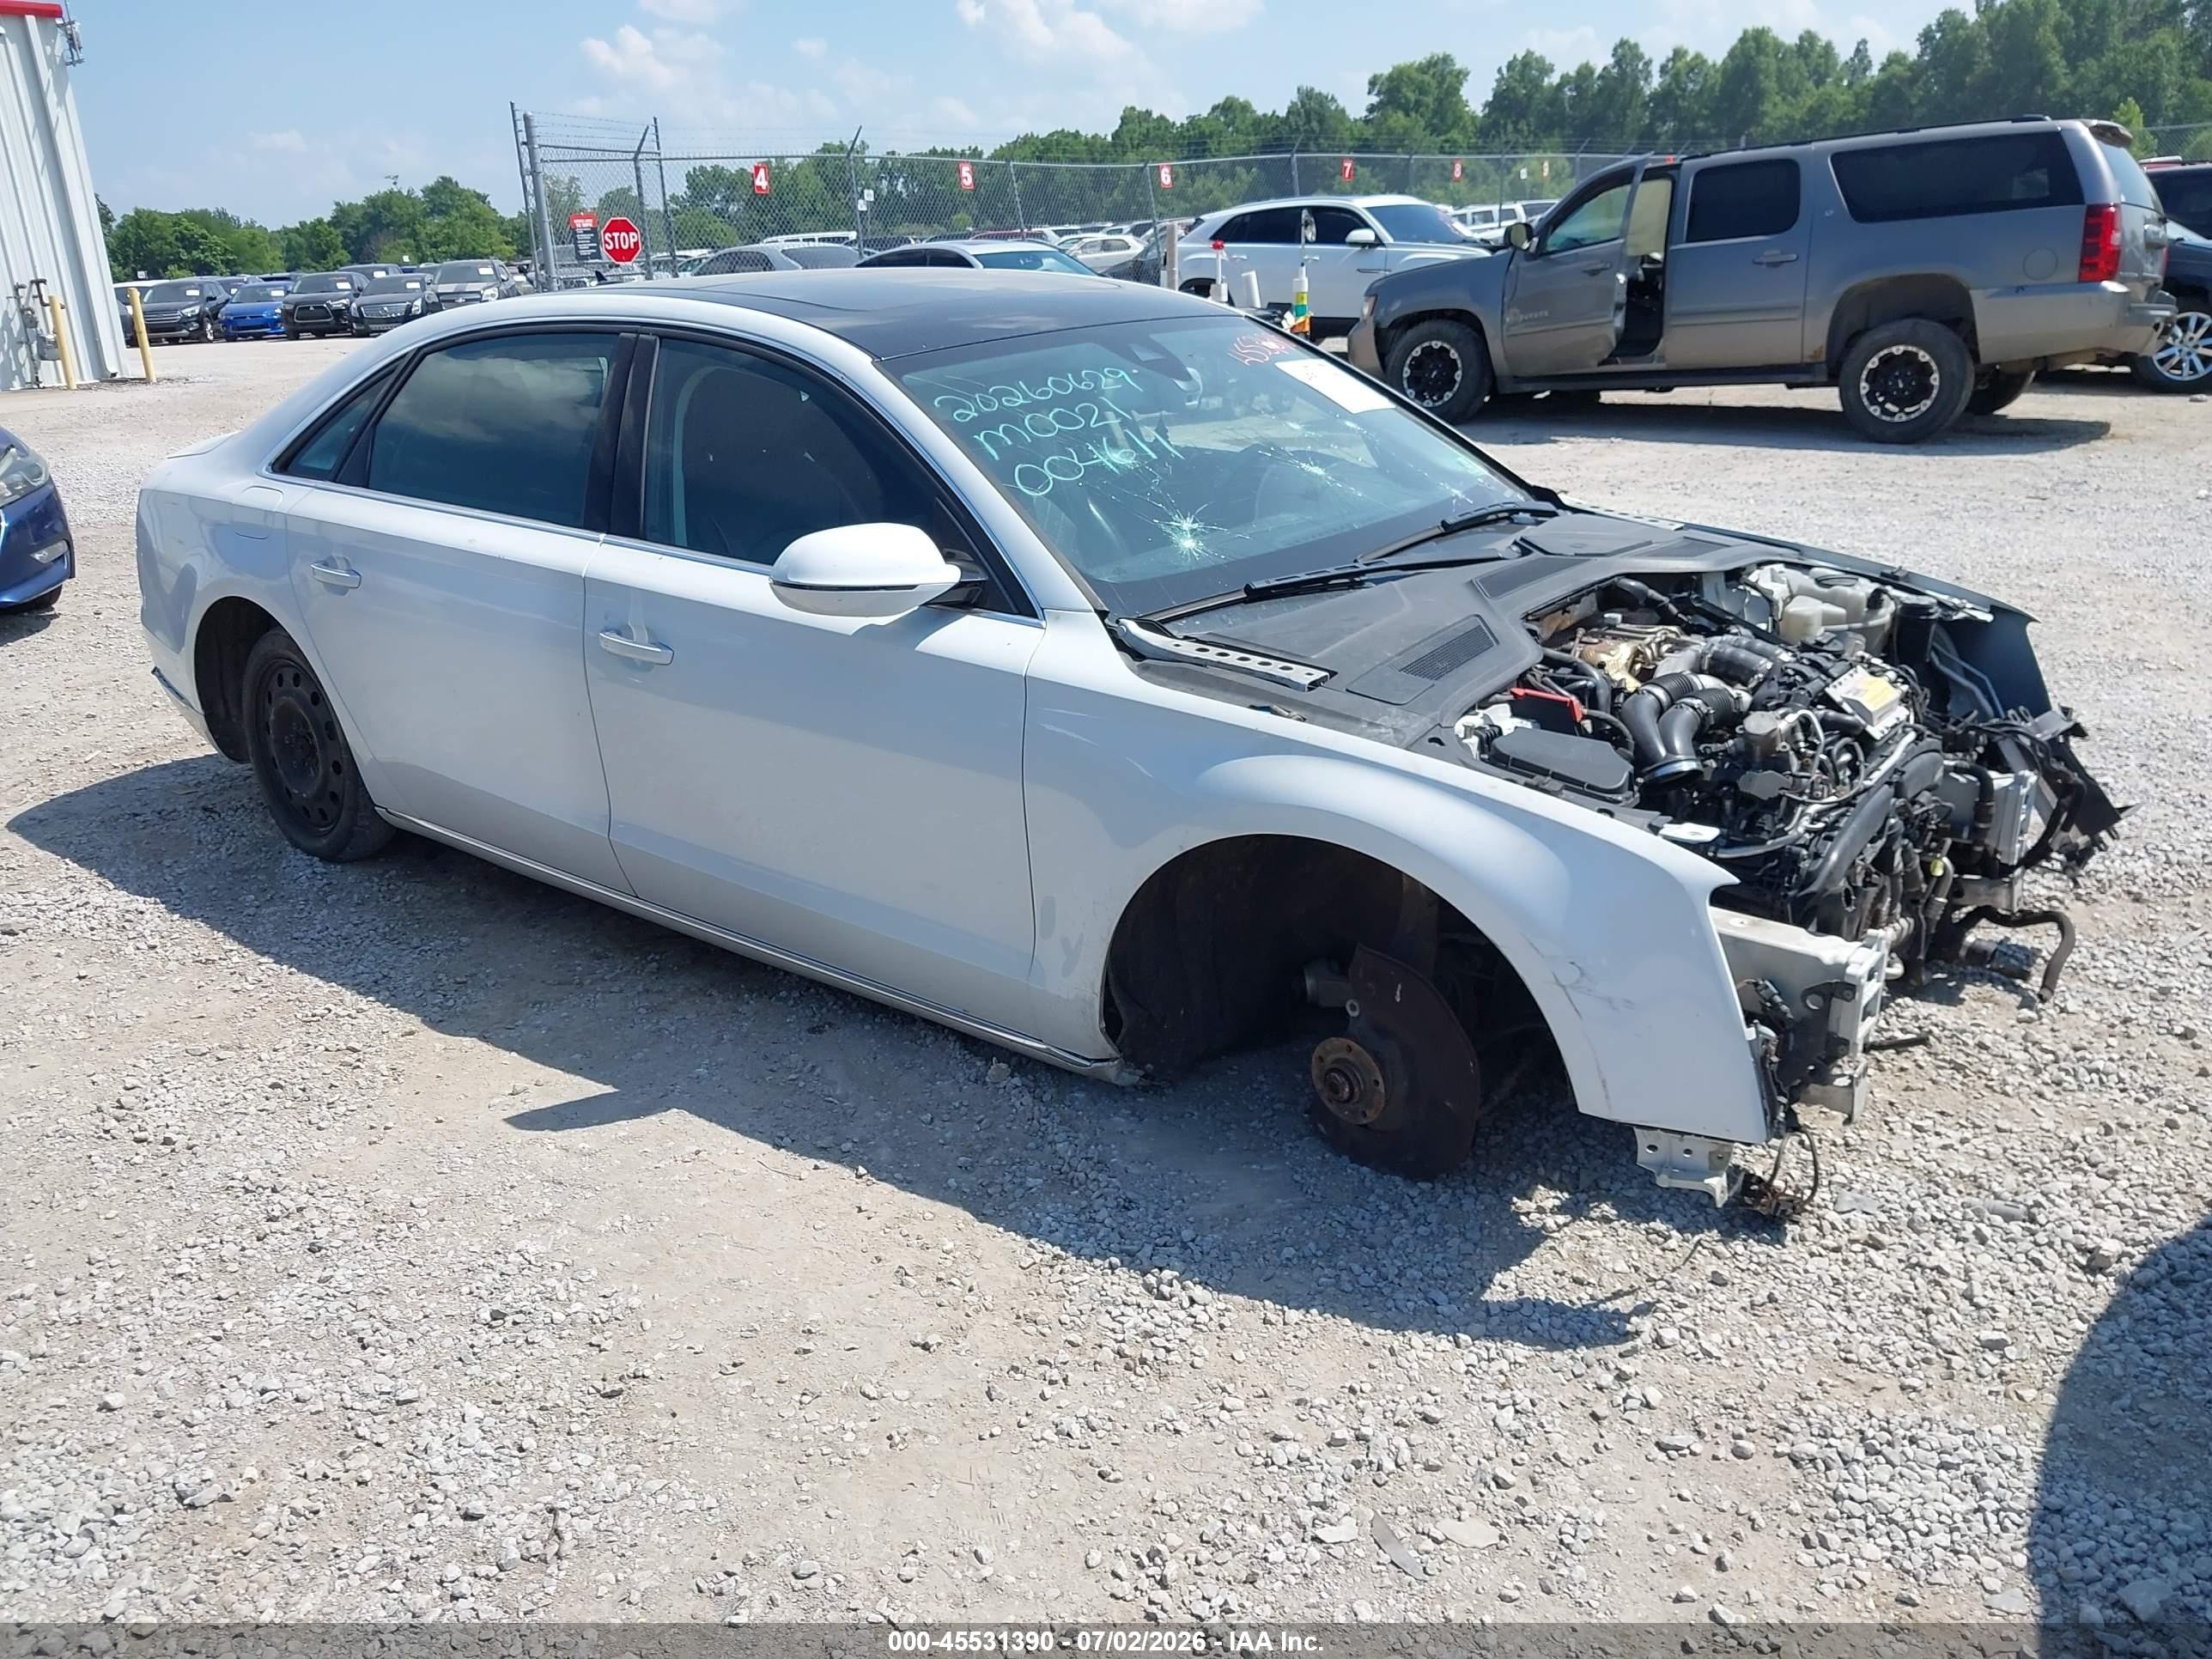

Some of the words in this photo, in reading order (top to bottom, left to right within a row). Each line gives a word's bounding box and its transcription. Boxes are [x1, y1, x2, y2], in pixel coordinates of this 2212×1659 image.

[755, 167, 769, 191] 4
[962, 166, 973, 186] 5
[1161, 167, 1171, 185] 6
[1343, 162, 1352, 179] 7
[1454, 163, 1462, 178] 8
[604, 232, 638, 251] STOP
[933, 367, 1144, 422] 20260629
[1014, 427, 1185, 495] 004611
